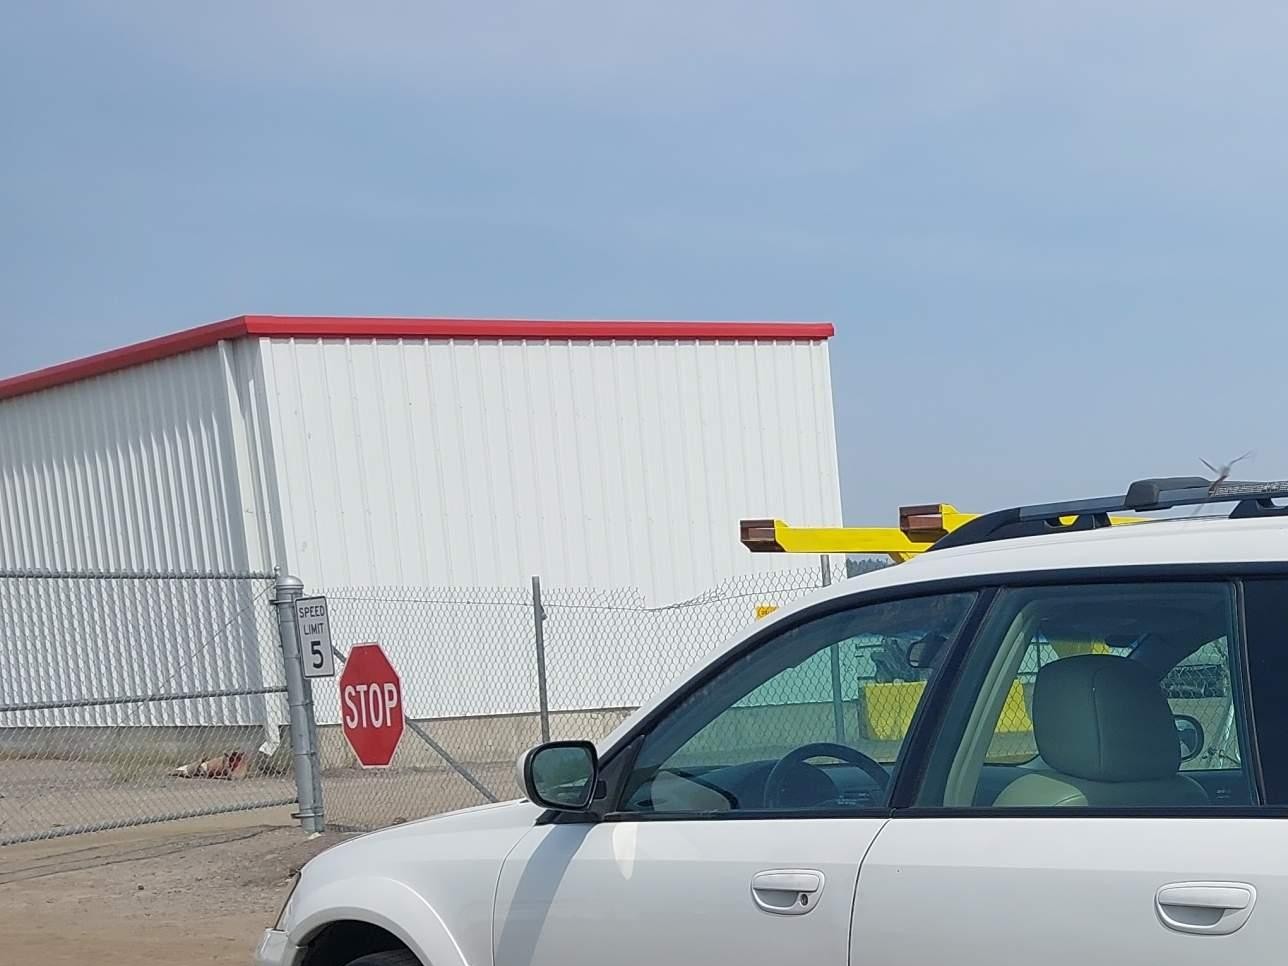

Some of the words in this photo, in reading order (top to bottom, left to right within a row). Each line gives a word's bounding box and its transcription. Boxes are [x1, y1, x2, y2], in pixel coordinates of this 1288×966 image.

[299, 605, 325, 618] SPEED
[304, 623, 324, 635] LIMIT
[311, 641, 324, 668] 5
[344, 683, 398, 729] STOP
